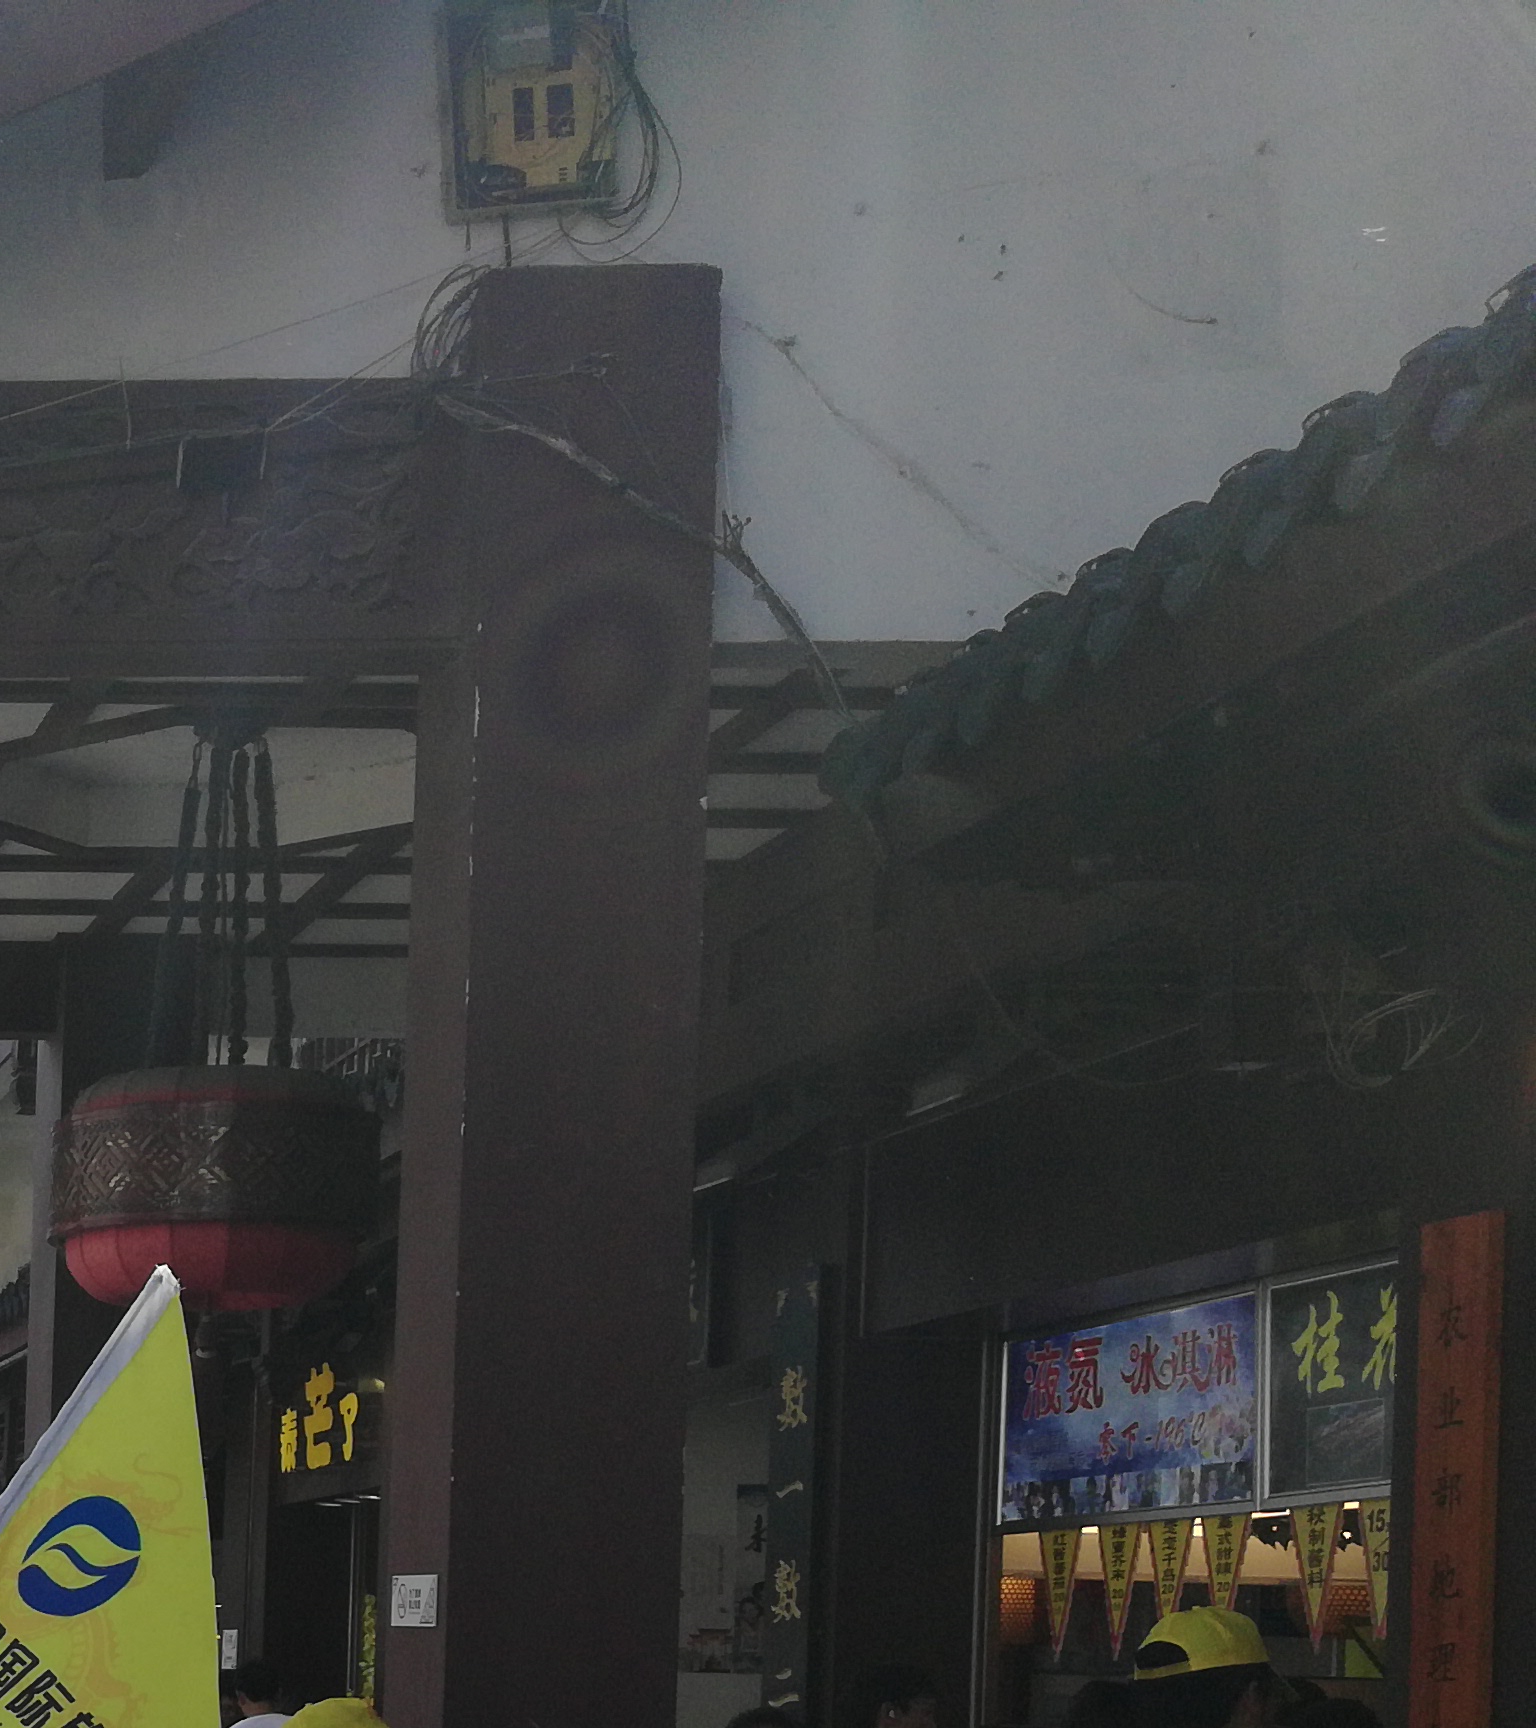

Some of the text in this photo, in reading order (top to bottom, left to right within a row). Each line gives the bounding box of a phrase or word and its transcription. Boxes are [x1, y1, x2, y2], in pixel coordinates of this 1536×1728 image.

[1022, 1323, 1238, 1420] 液氮 冰淇淋
